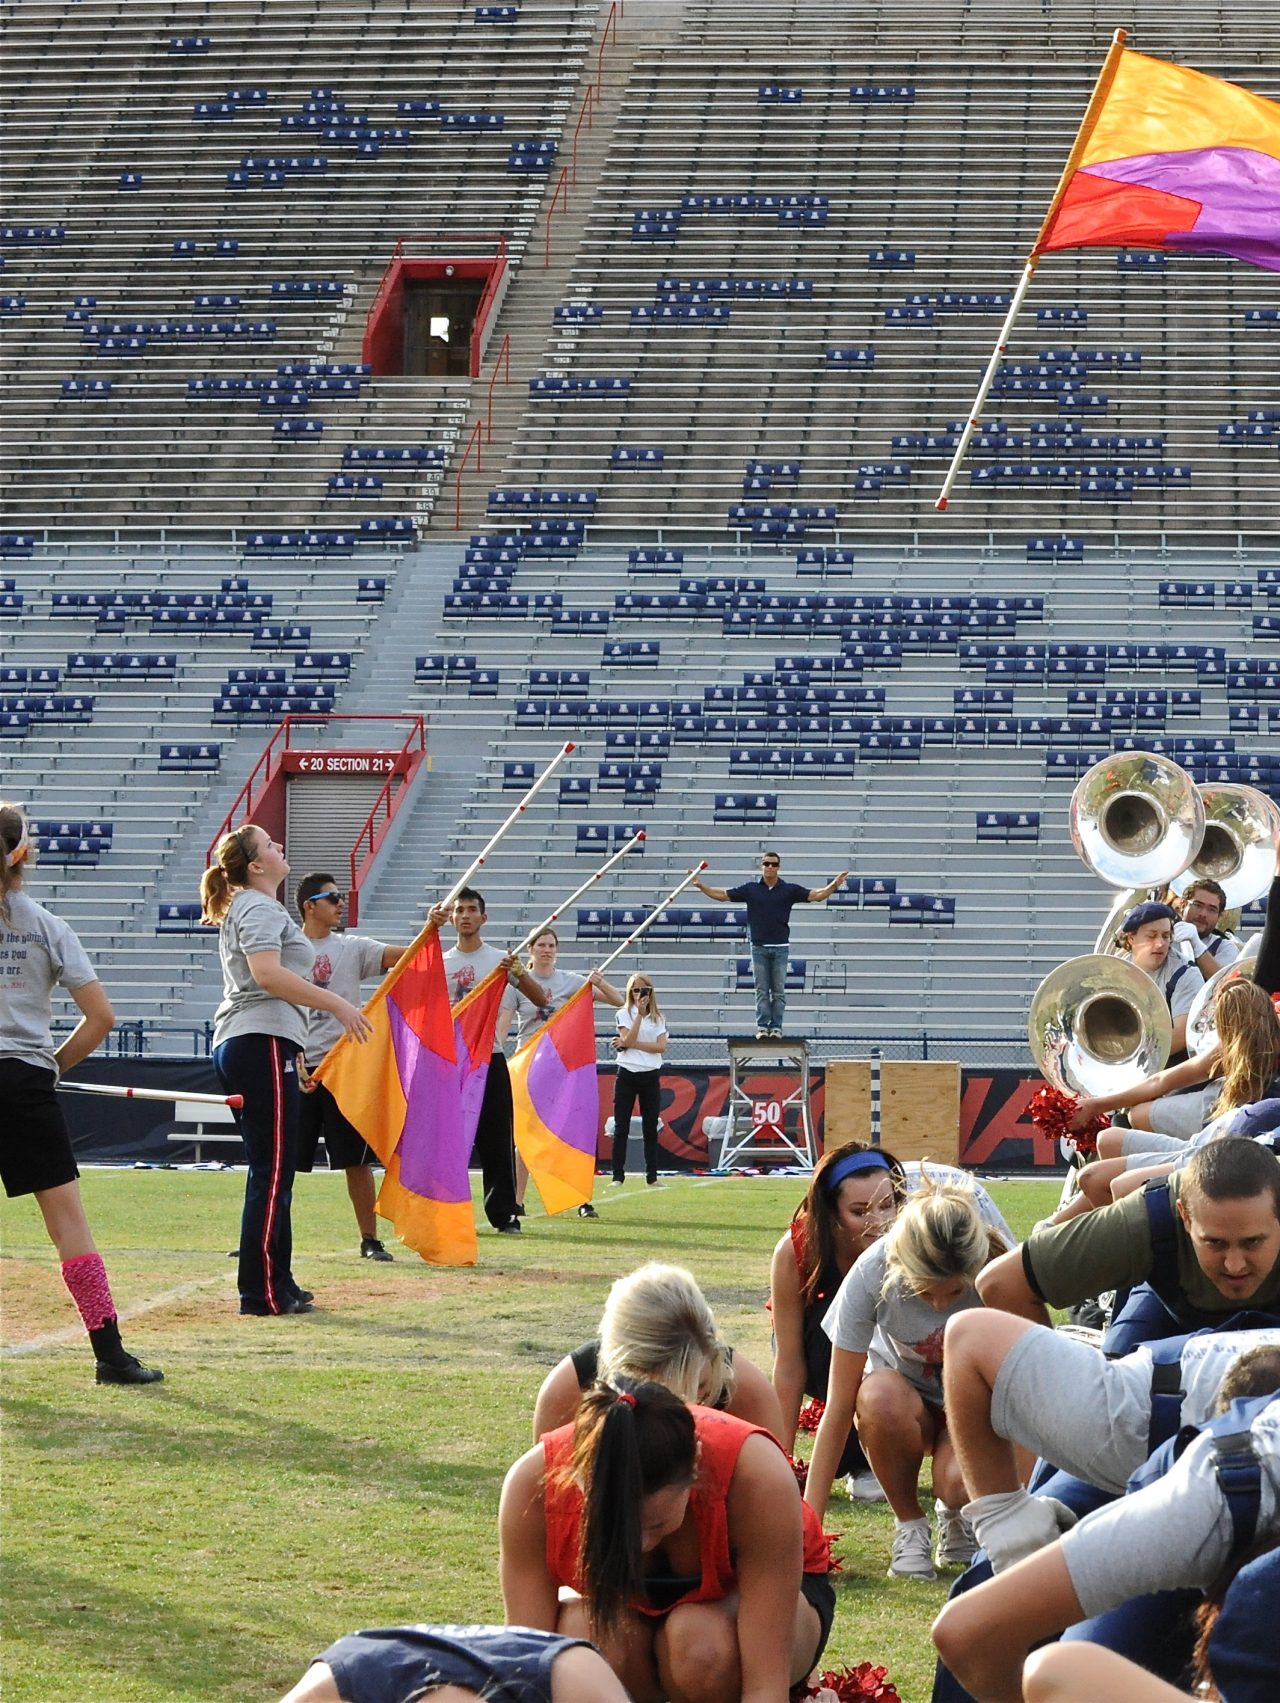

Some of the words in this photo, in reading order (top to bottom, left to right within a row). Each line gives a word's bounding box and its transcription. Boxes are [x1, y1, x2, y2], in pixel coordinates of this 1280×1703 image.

[310, 758, 324, 770] 20
[327, 758, 369, 771] SECTION
[372, 758, 384, 771] 21
[753, 1102, 780, 1125] 50
